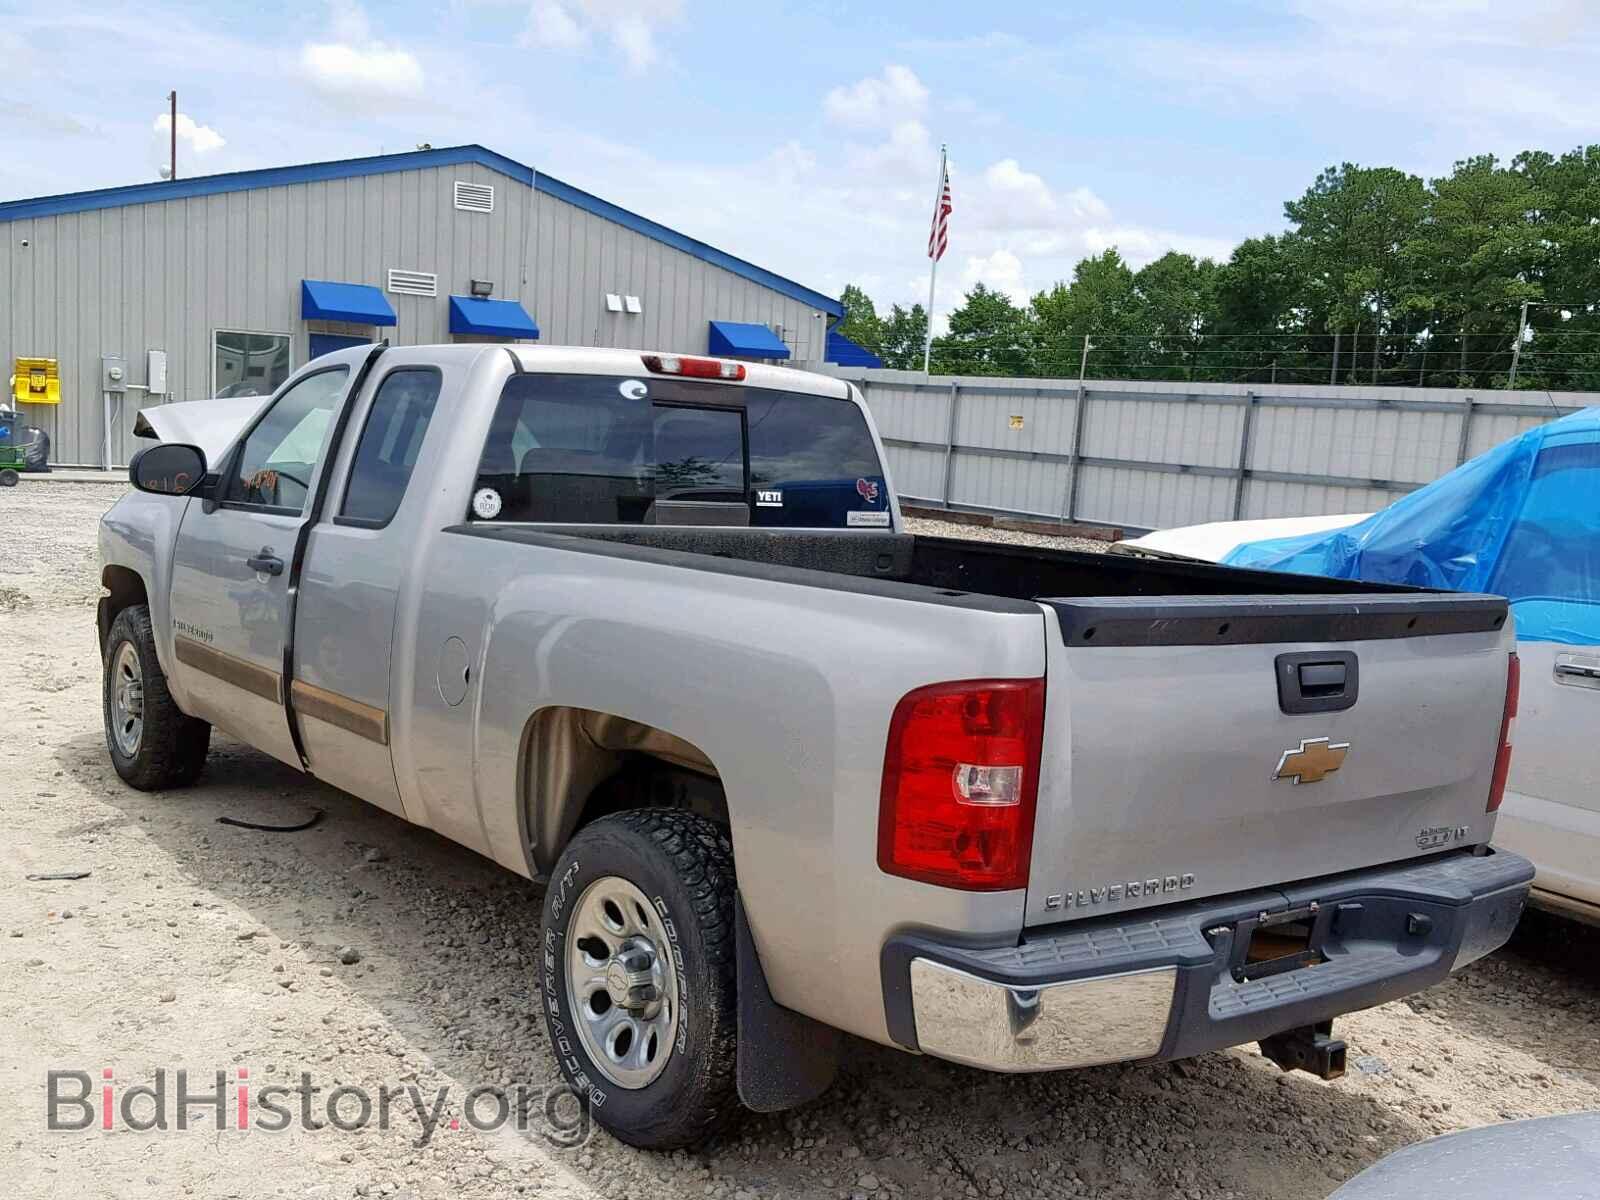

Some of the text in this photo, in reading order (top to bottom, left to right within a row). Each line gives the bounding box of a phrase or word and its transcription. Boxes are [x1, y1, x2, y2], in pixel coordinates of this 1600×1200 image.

[757, 491, 782, 502] YETI
[1045, 872, 1195, 912] SILVERADO
[544, 927, 607, 1106] DISCOVERER
[653, 895, 687, 1055] COOPER
